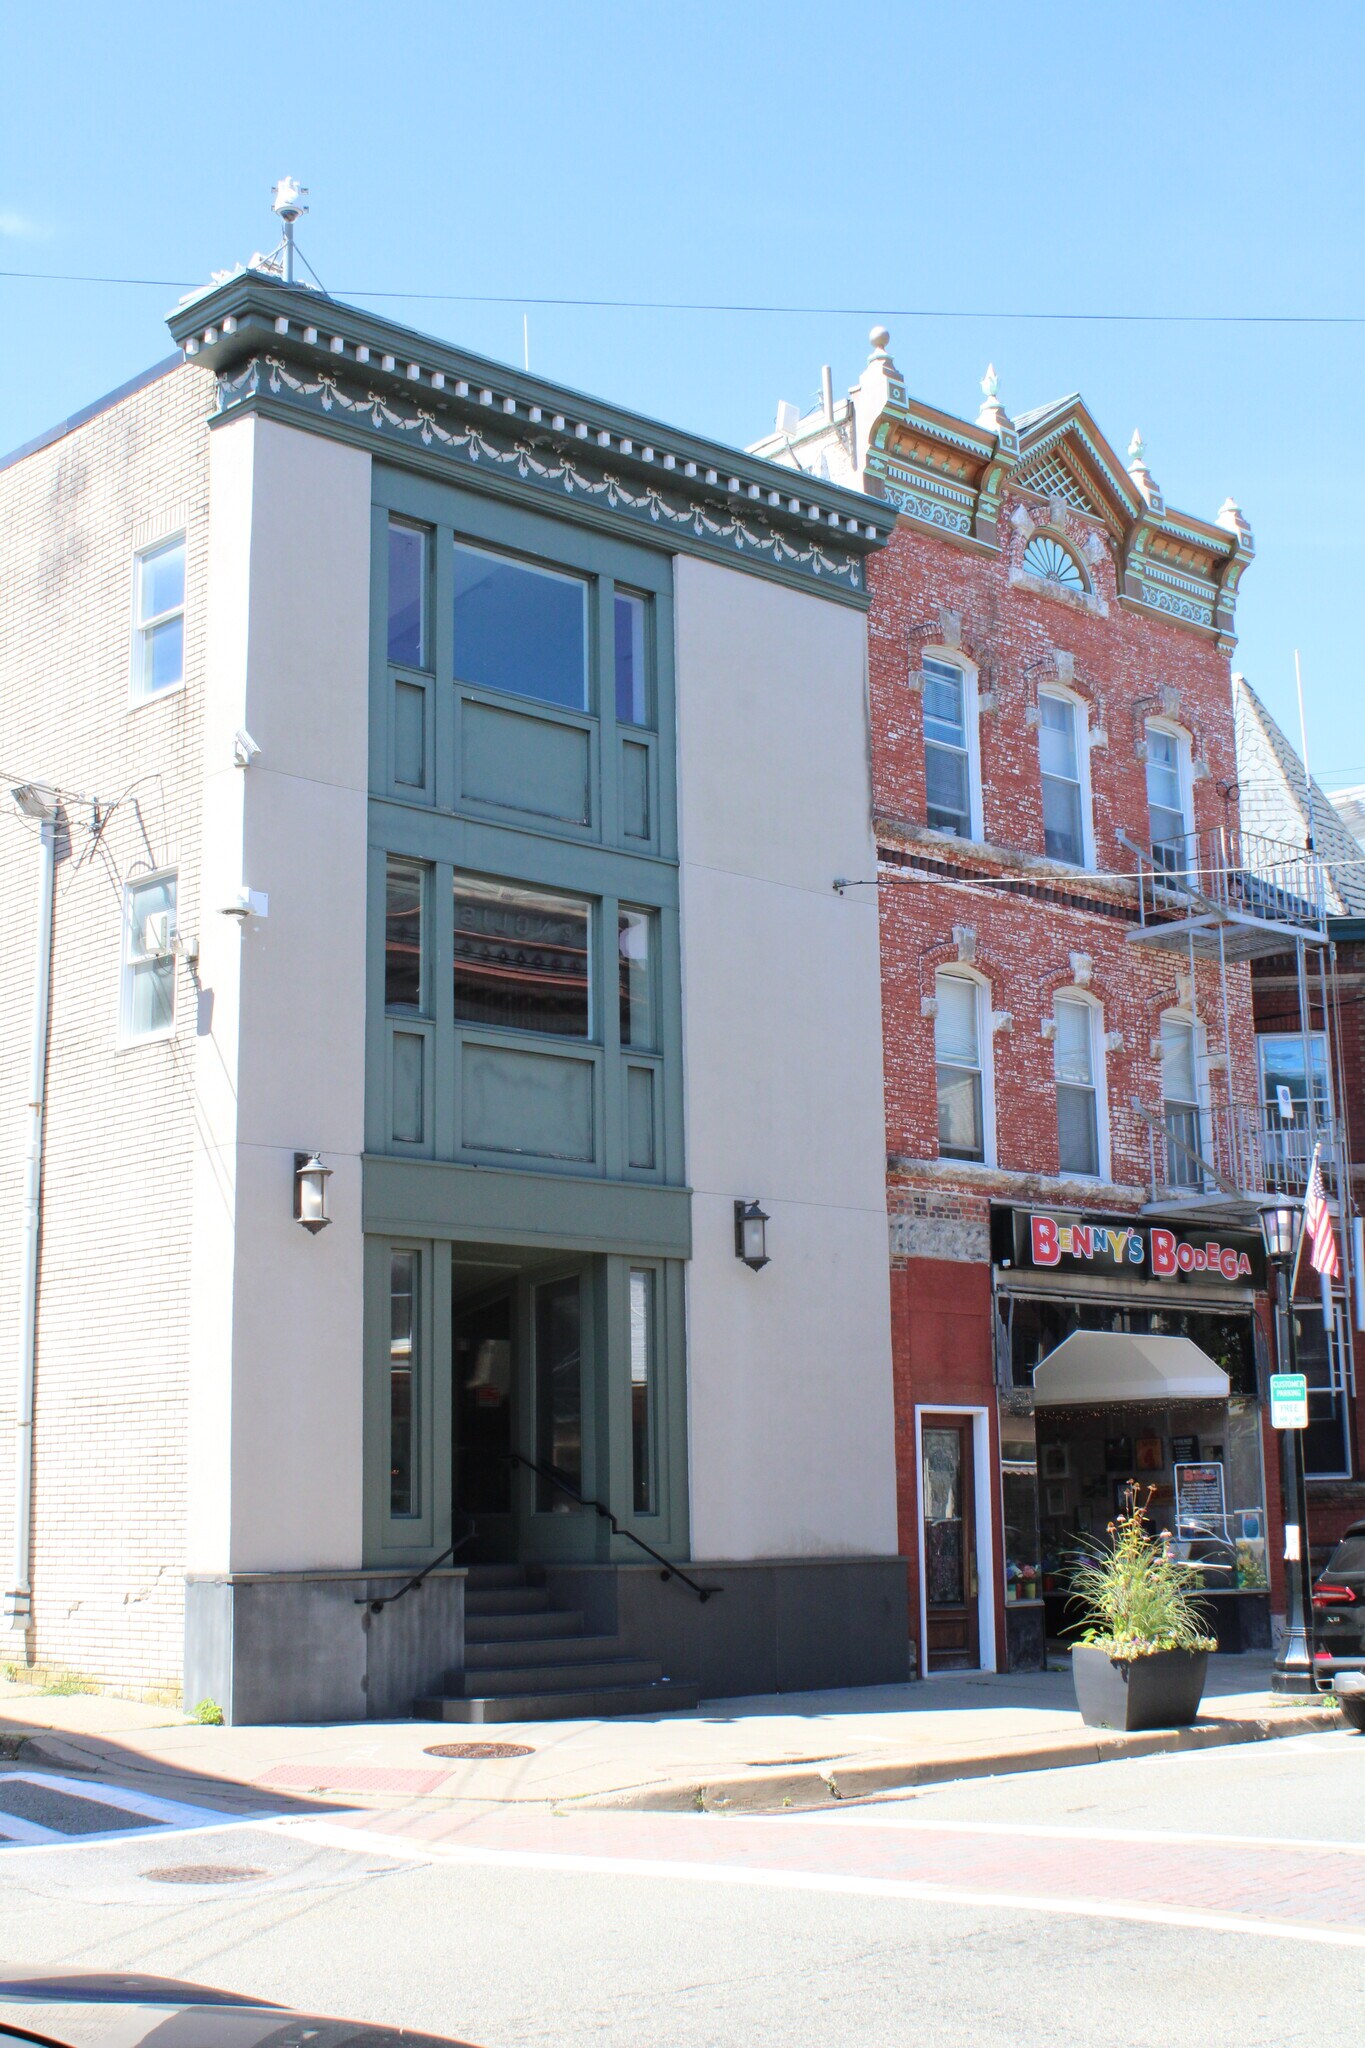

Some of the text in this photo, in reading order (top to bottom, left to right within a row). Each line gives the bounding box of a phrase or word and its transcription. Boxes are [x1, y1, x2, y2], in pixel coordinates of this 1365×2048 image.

[1030, 1215, 1252, 1281] BENNY'S BODEGA
[1273, 1380, 1304, 1388] CUSTOMER
[1277, 1389, 1301, 1397] PARKING
[1280, 1404, 1299, 1412] FREE
